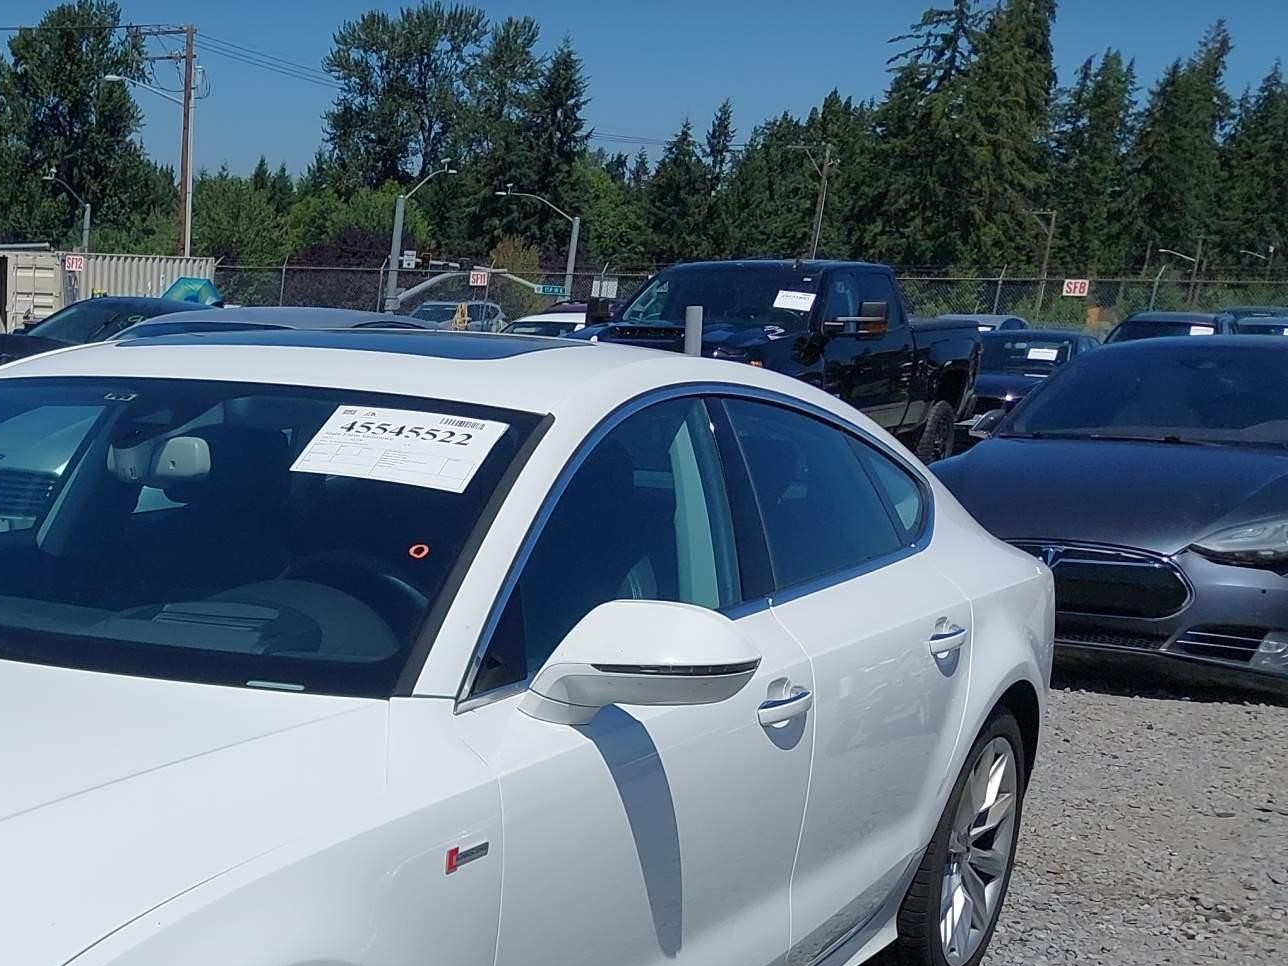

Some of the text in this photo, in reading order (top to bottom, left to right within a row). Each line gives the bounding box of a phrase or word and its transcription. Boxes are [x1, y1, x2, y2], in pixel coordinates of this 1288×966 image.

[67, 257, 83, 269] SF12
[471, 273, 486, 284] SF11
[1065, 281, 1087, 294] SF8
[340, 420, 473, 446] 45545522
